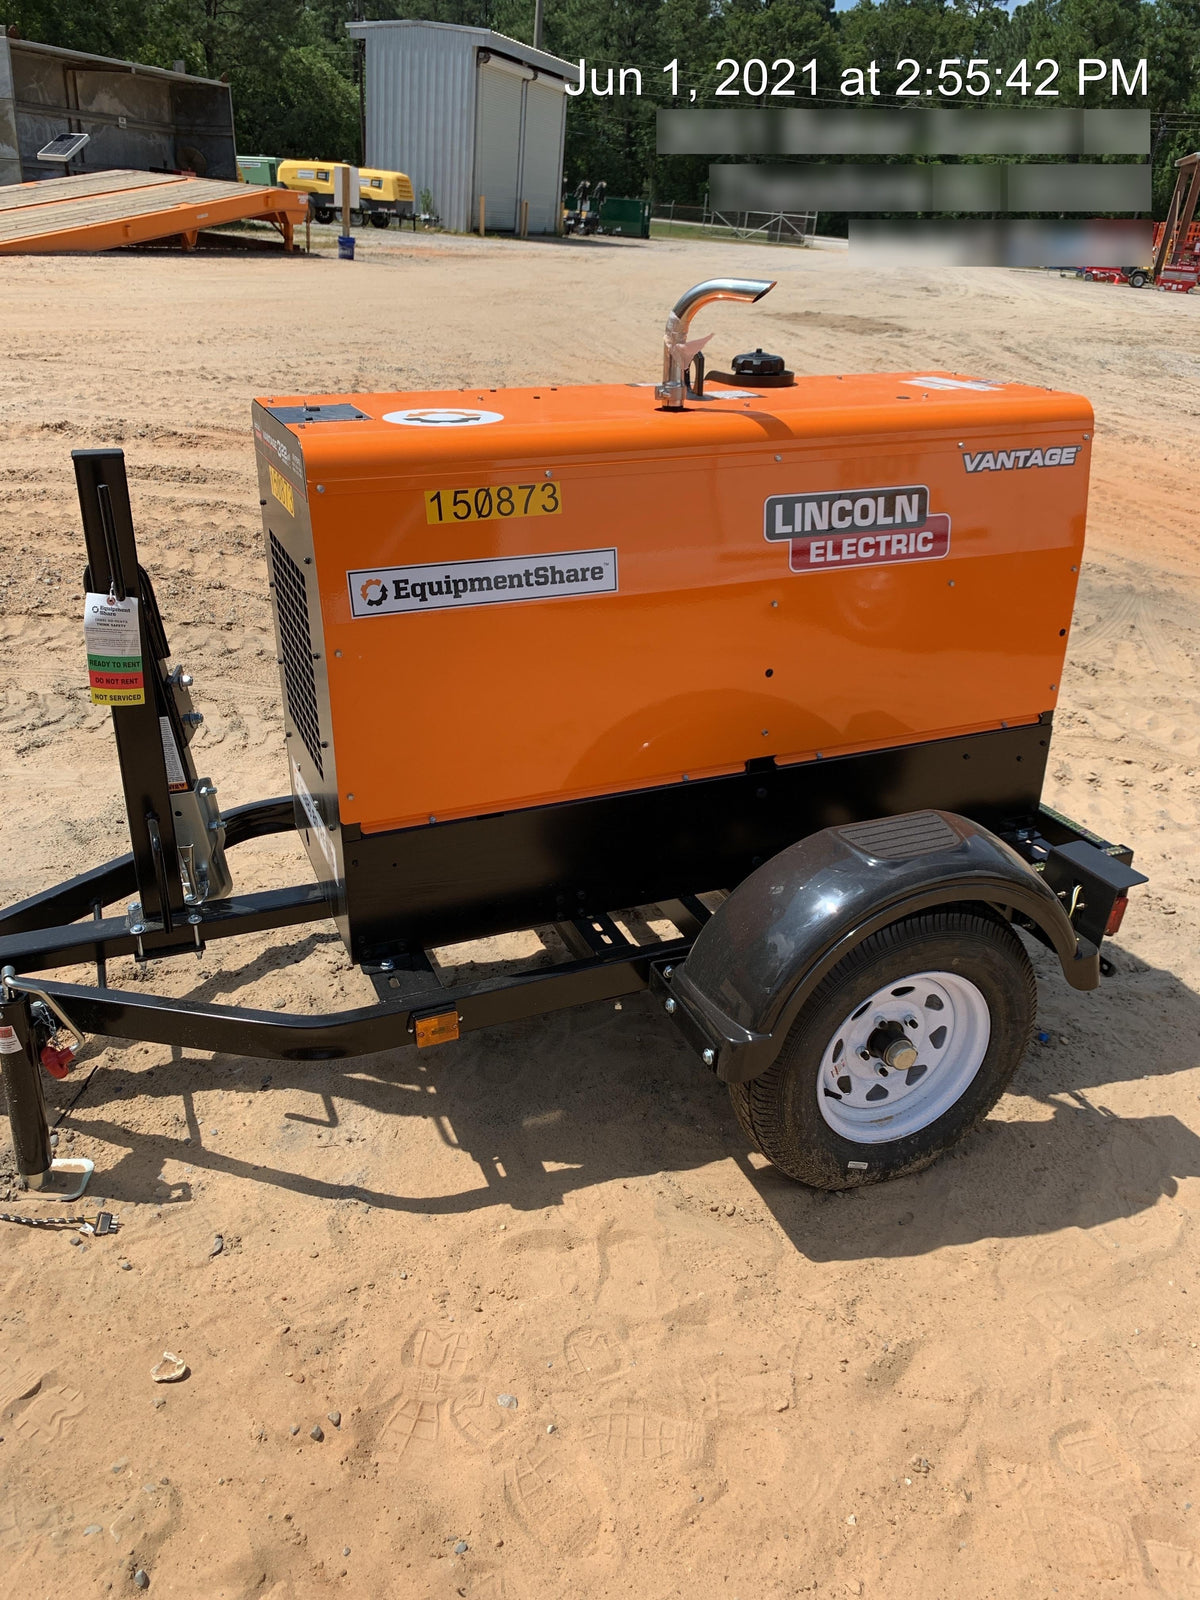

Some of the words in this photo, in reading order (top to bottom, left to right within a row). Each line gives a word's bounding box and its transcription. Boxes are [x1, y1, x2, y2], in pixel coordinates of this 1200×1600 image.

[963, 446, 1078, 473] VANTAGE
[430, 482, 559, 522] 150873
[774, 493, 919, 534] LINCOLN
[809, 531, 934, 563] ELECTRIC
[100, 605, 130, 613] Equipment
[90, 659, 110, 668] READY
[120, 677, 138, 685] RENT
